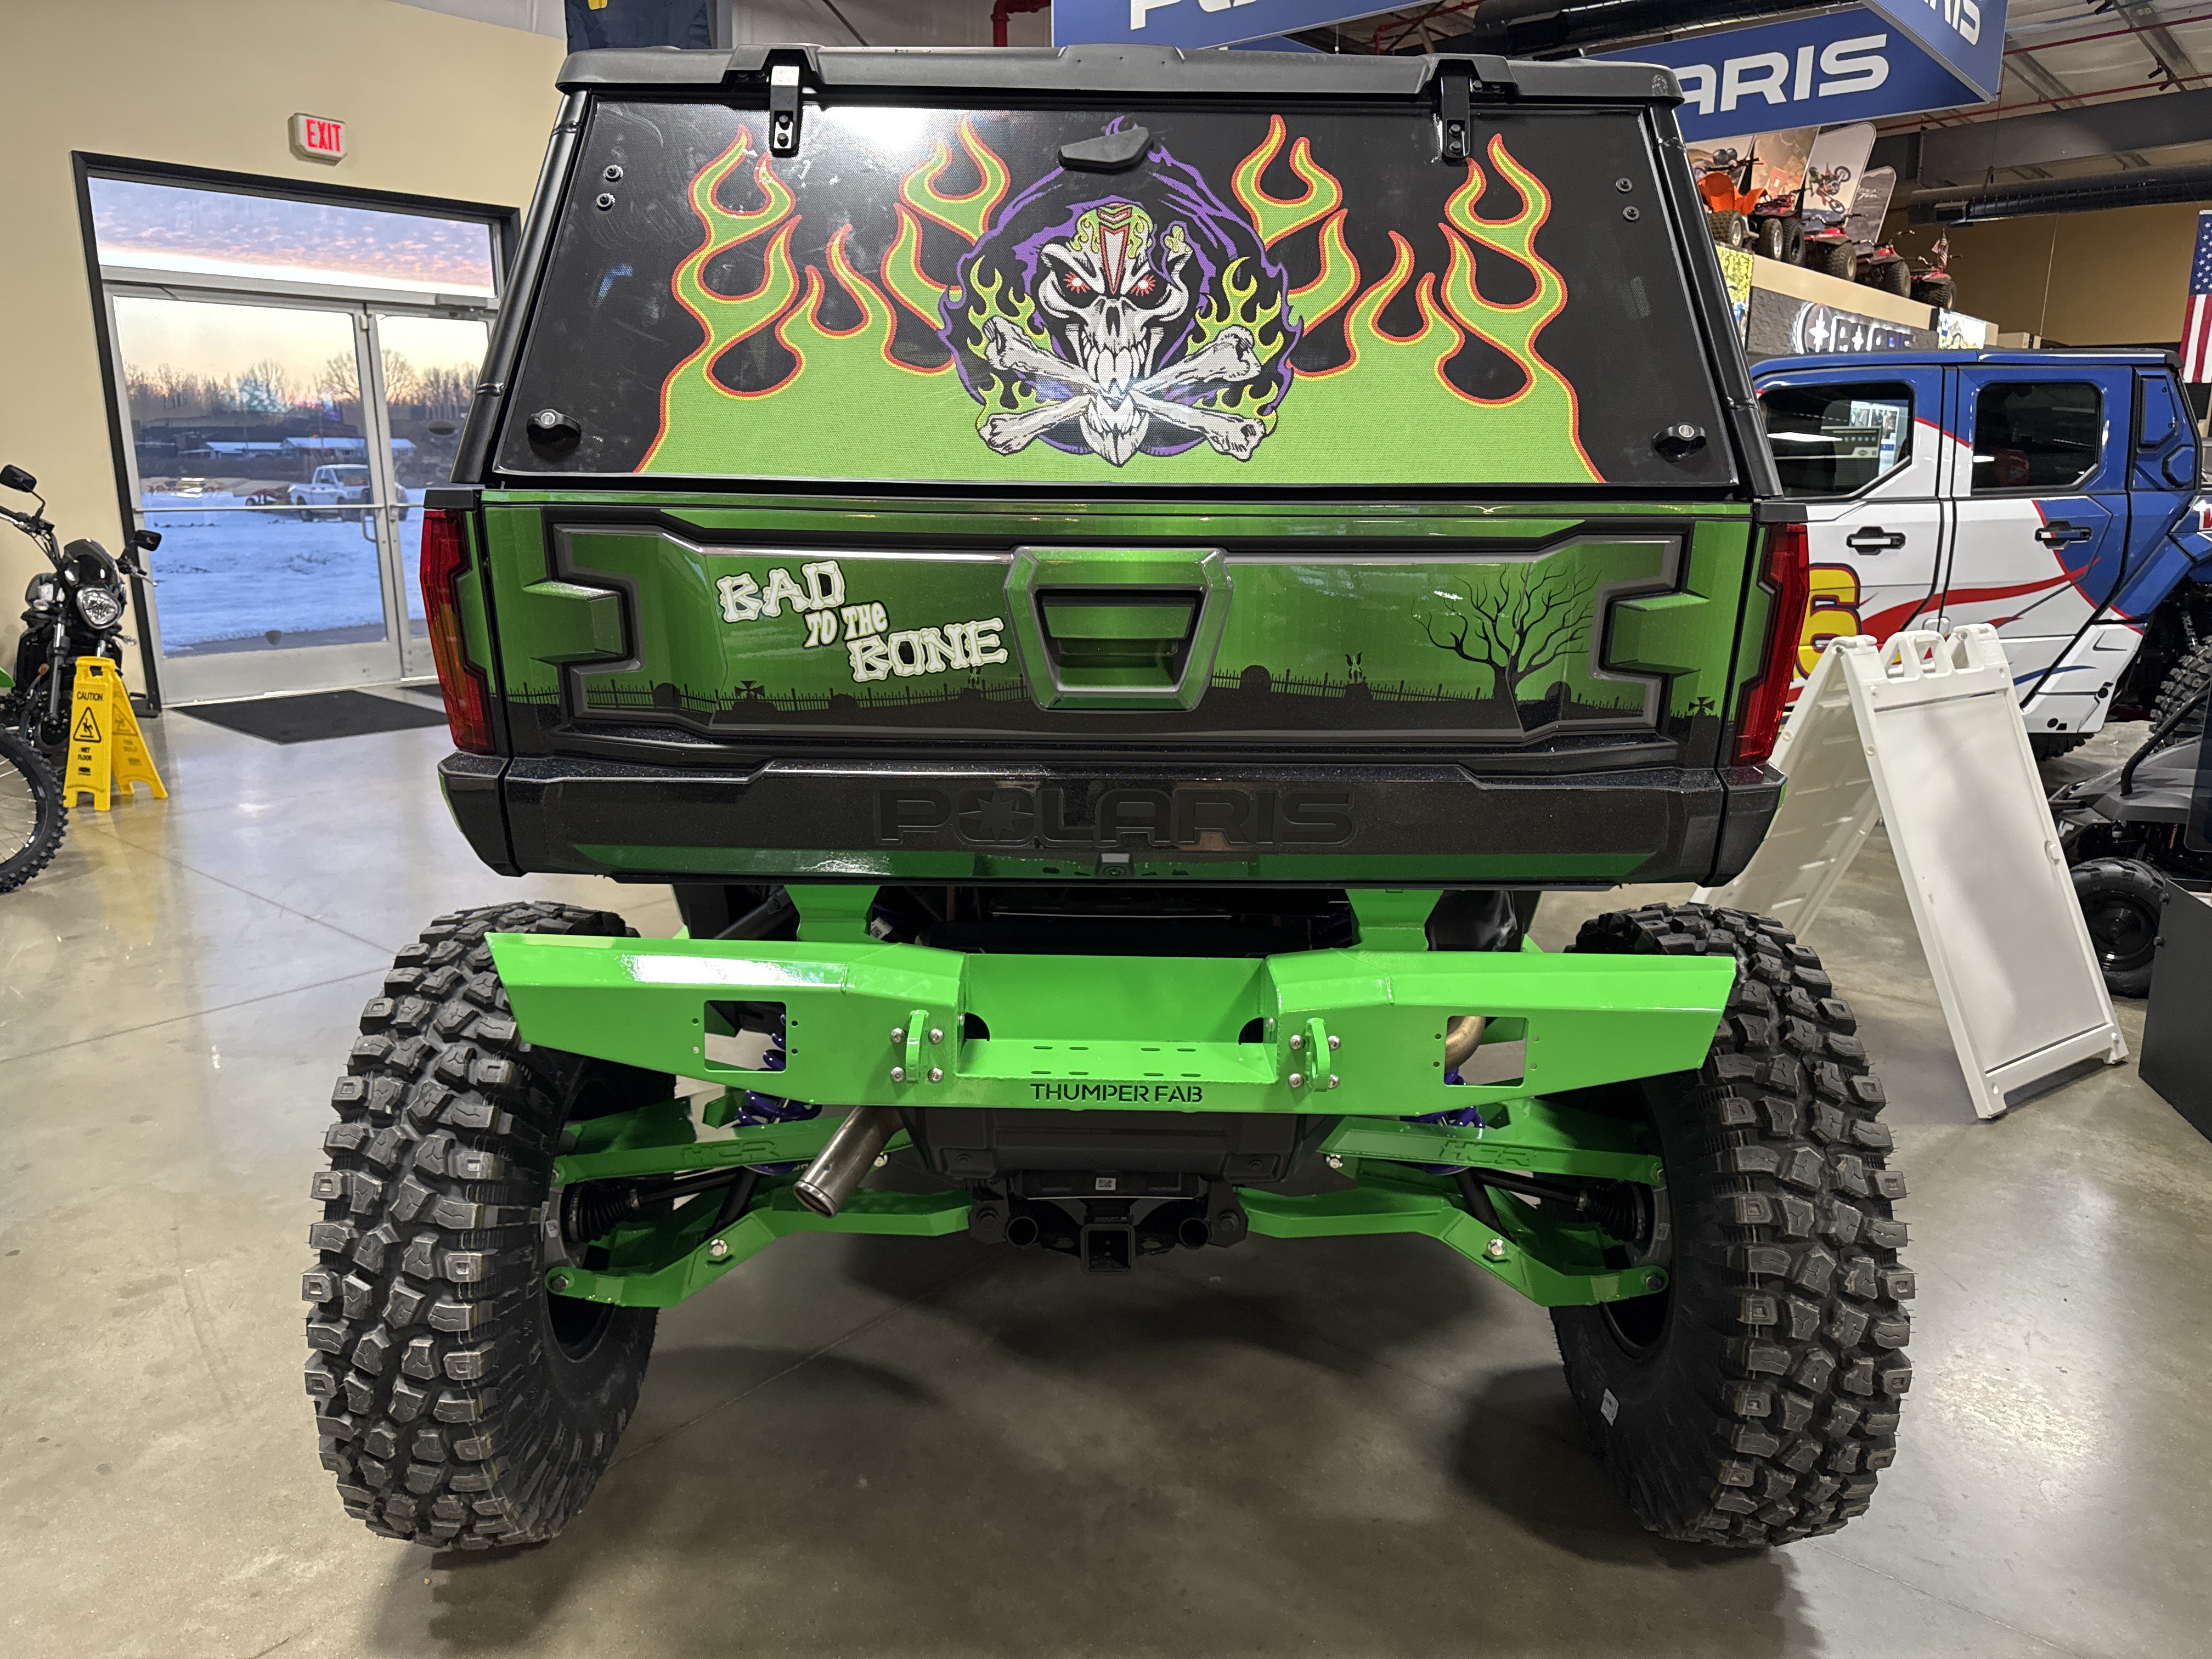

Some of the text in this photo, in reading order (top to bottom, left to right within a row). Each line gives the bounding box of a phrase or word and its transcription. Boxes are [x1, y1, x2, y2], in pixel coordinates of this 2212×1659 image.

[306, 119, 341, 153] EXIT
[716, 560, 845, 623] BAD
[804, 609, 838, 648] TO
[849, 617, 1008, 682] BONE
[77, 691, 103, 701] CAUTION
[877, 787, 1357, 848] POLARIS
[1030, 1083, 1203, 1104] THUMPER FAB
